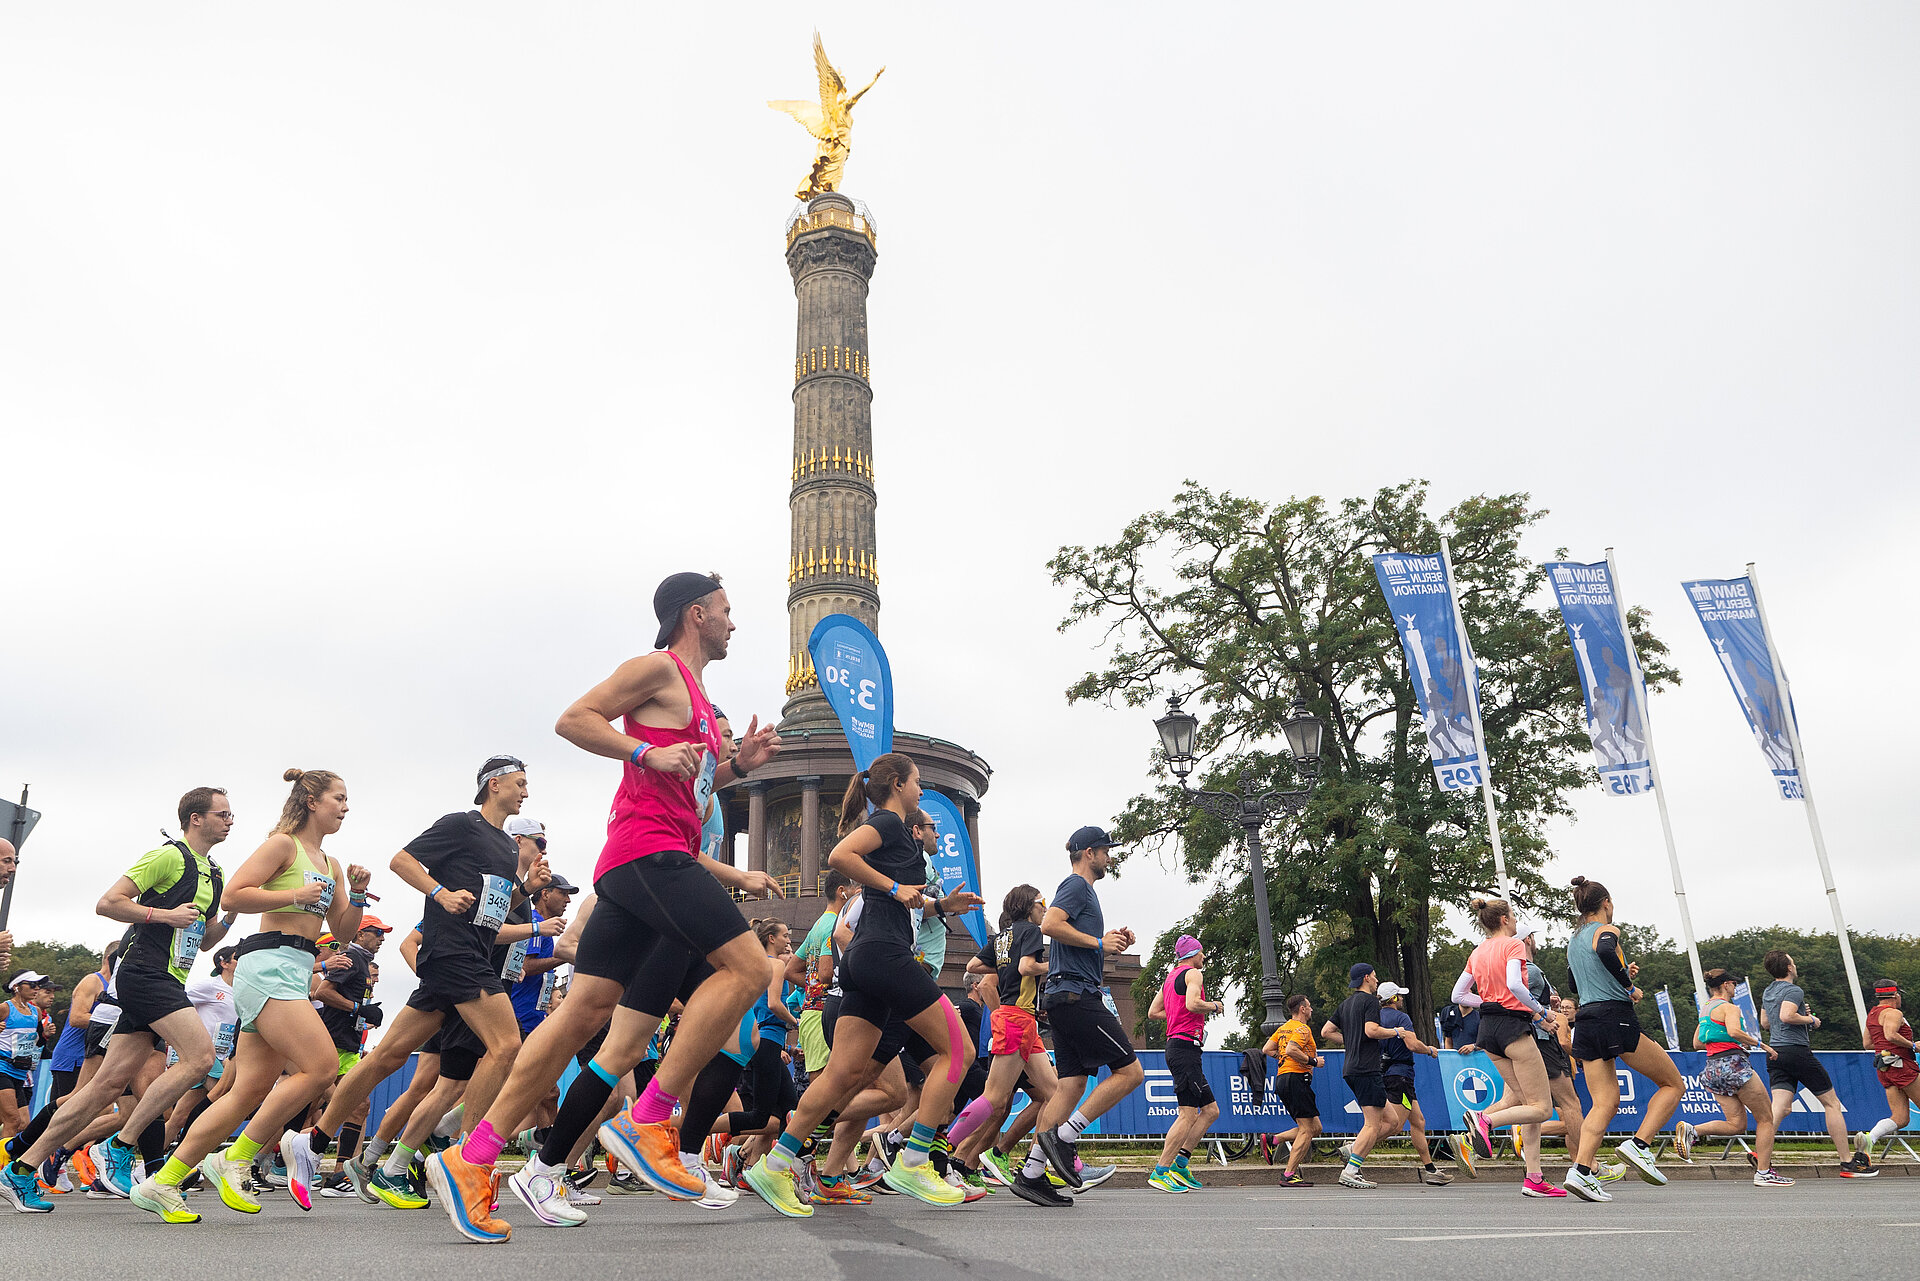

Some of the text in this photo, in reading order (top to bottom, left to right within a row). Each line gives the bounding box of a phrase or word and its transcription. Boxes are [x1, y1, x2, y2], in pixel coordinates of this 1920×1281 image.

[1458, 1070, 1489, 1083] BMW
[1680, 1091, 1716, 1102] BERLI
[1147, 1106, 1180, 1116] Abbot
[615, 1114, 641, 1145] HOKA
